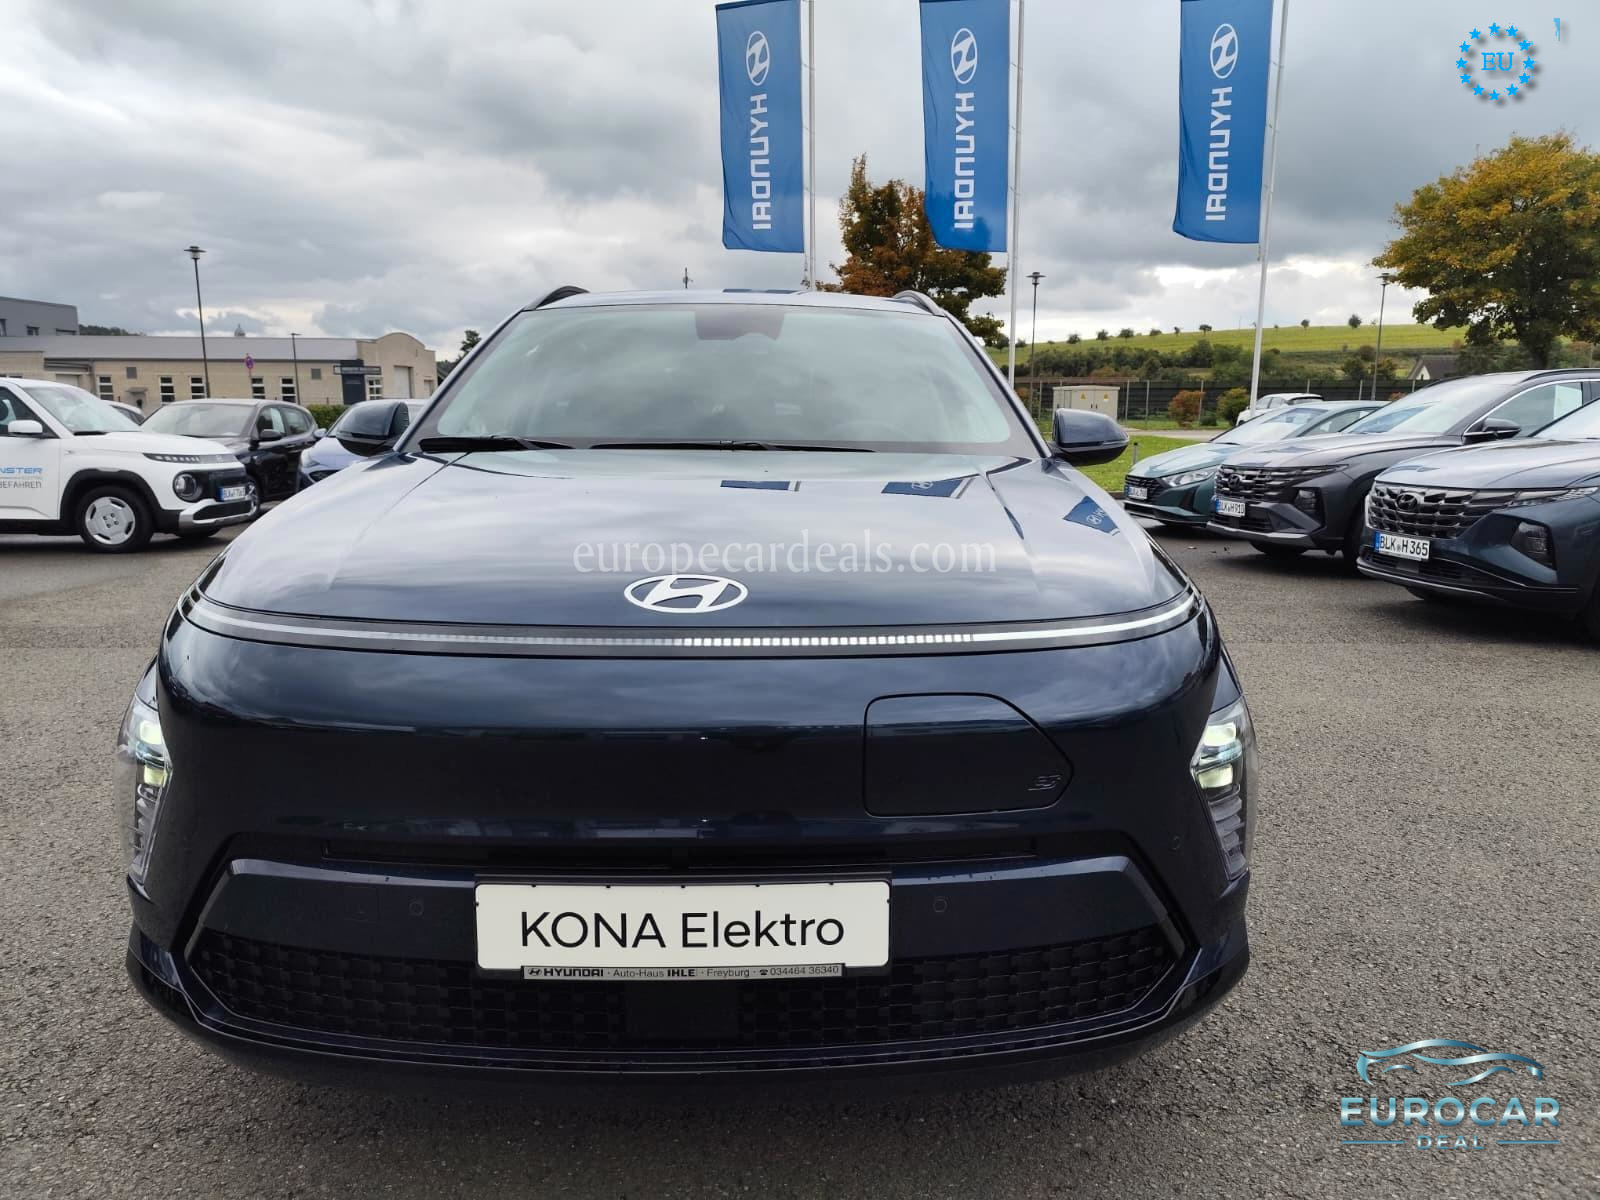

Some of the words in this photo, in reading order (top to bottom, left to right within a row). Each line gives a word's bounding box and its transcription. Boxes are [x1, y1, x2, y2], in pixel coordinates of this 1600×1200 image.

[521, 911, 666, 949] KONA
[681, 910, 845, 948] Elektro
[544, 968, 604, 977] HYUNDAI
[613, 968, 665, 978] Auto-Haus
[667, 968, 696, 977] IHLE
[706, 968, 750, 978] Freyburg
[769, 966, 806, 976] 034464
[808, 965, 839, 975] 36340
